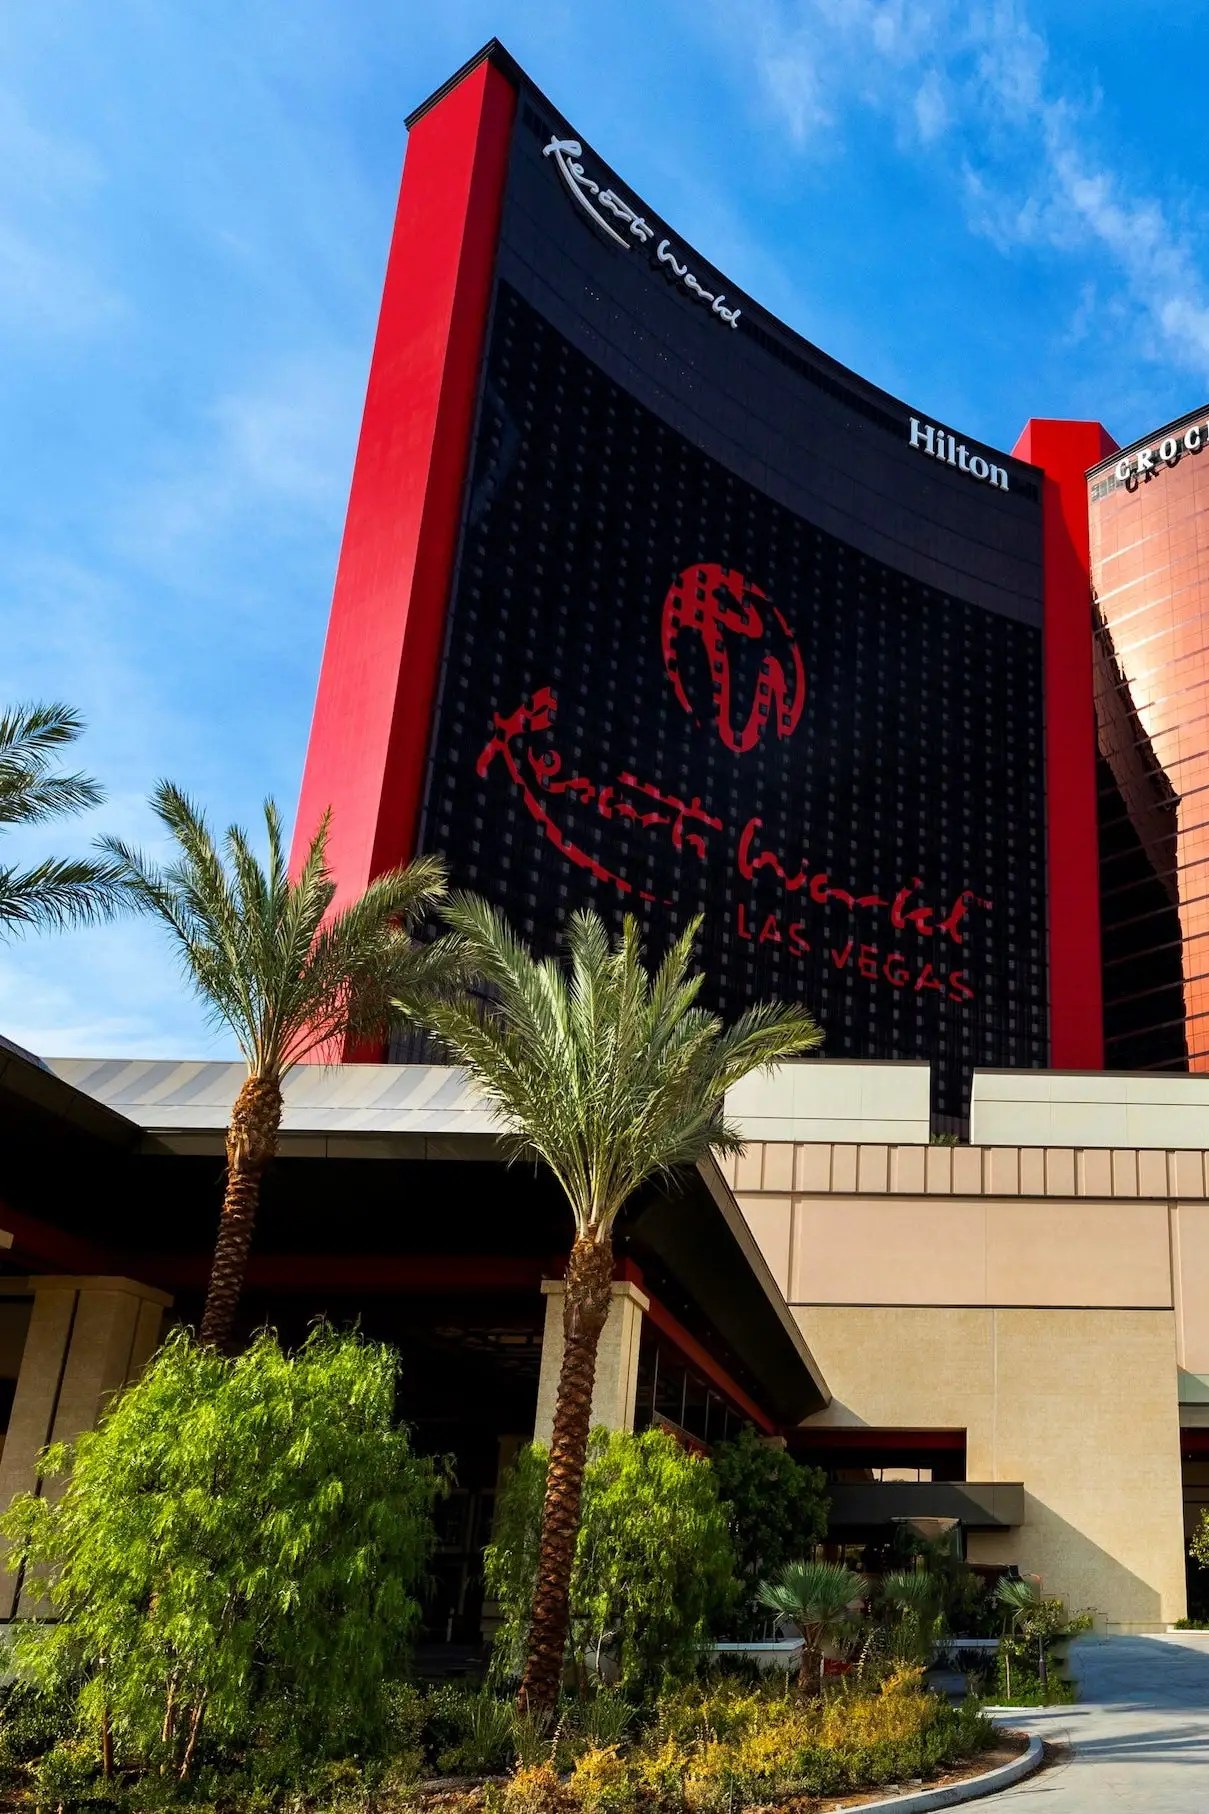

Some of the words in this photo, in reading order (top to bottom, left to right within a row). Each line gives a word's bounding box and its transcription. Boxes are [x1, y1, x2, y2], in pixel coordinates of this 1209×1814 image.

[542, 135, 655, 249] Resorts
[656, 239, 742, 328] World
[908, 416, 1010, 493] Hilton
[736, 903, 811, 957] LAS
[830, 940, 975, 1003] VEGAS
